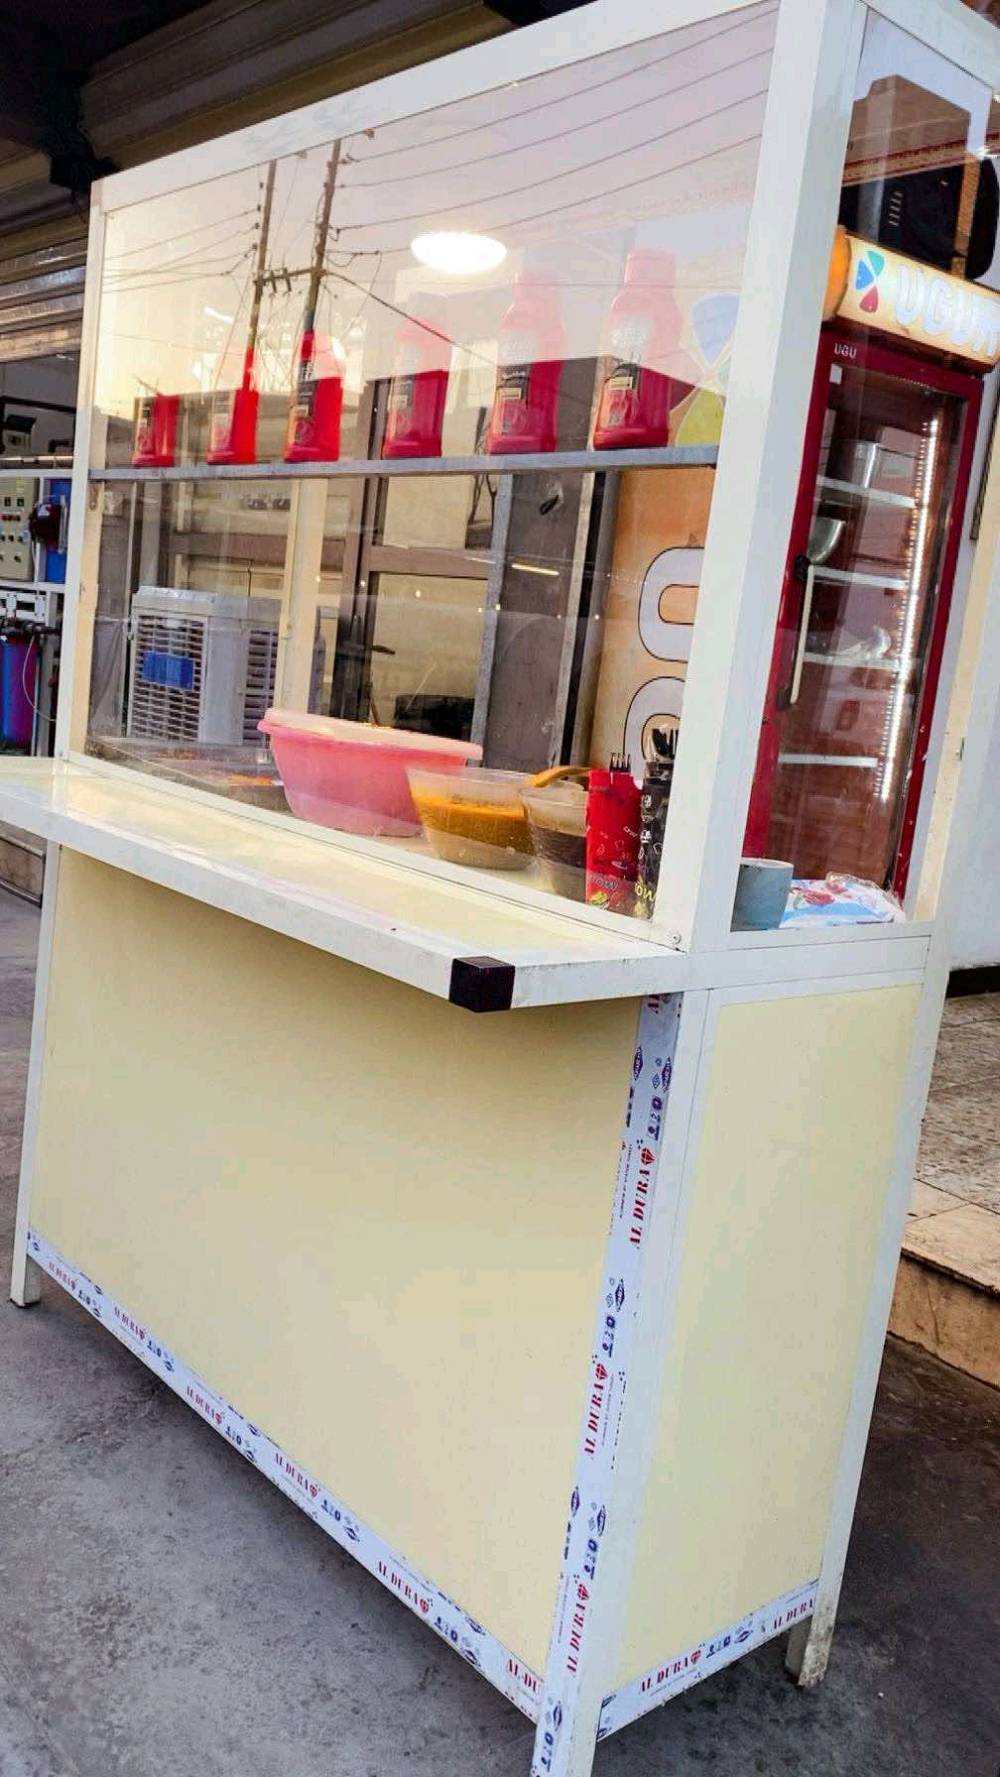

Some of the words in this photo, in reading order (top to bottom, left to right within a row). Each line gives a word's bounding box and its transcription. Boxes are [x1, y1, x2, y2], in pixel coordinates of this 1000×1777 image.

[633, 1168, 650, 1221] DURA
[629, 1226, 642, 1250] AL
[587, 1383, 605, 1433] DURA
[584, 1437, 596, 1461] AL
[375, 1560, 389, 1578] AL
[390, 1571, 419, 1605] DURA
[568, 1602, 587, 1653] DURA
[566, 1657, 578, 1678] AL
[656, 1656, 689, 1683] DURA
